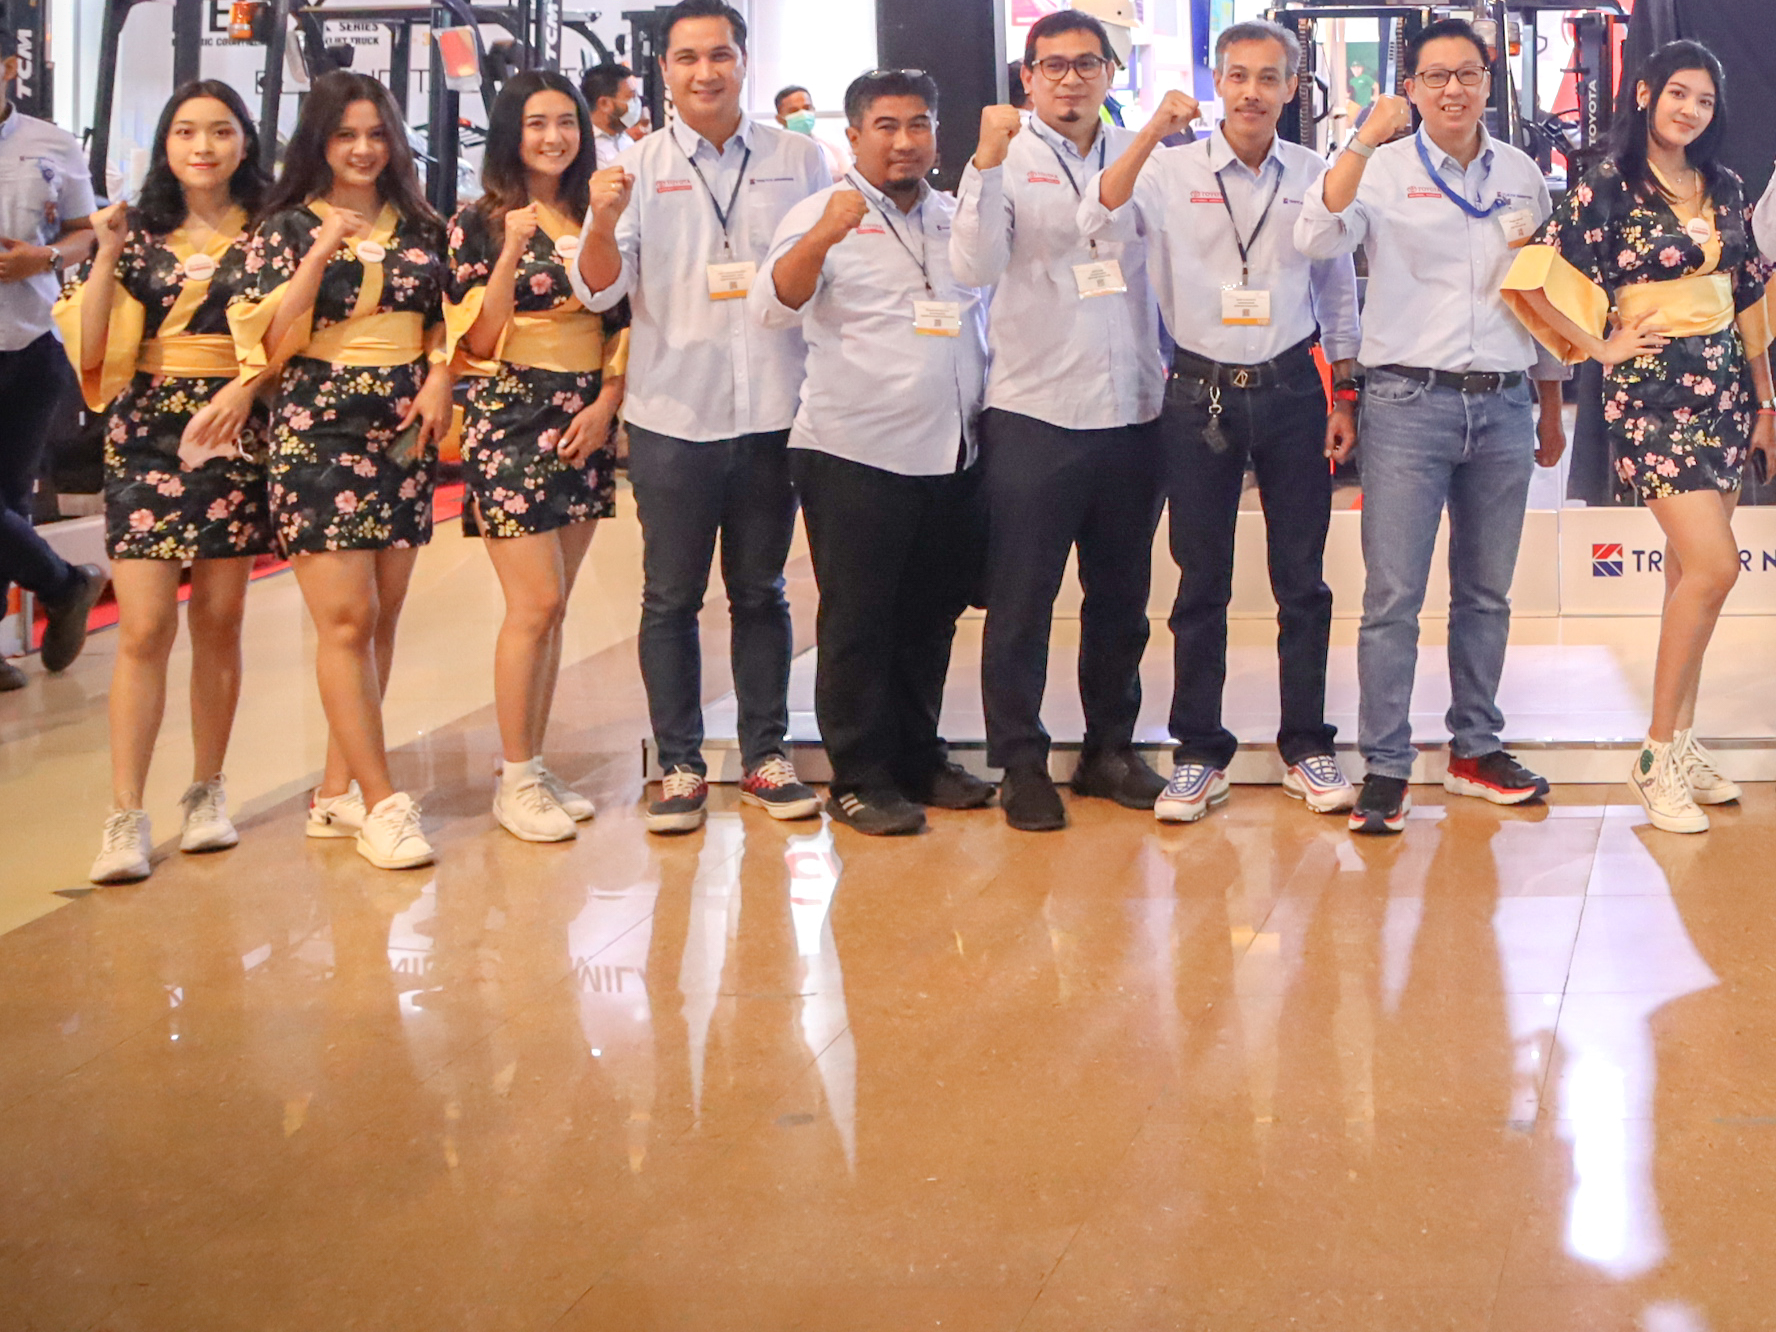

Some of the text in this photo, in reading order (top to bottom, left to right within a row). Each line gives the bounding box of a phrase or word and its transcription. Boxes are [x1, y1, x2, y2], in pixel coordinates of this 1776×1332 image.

[16, 28, 33, 100] TCM
[544, 2, 559, 62] TCM
[1588, 79, 1598, 147] TOYOTA
